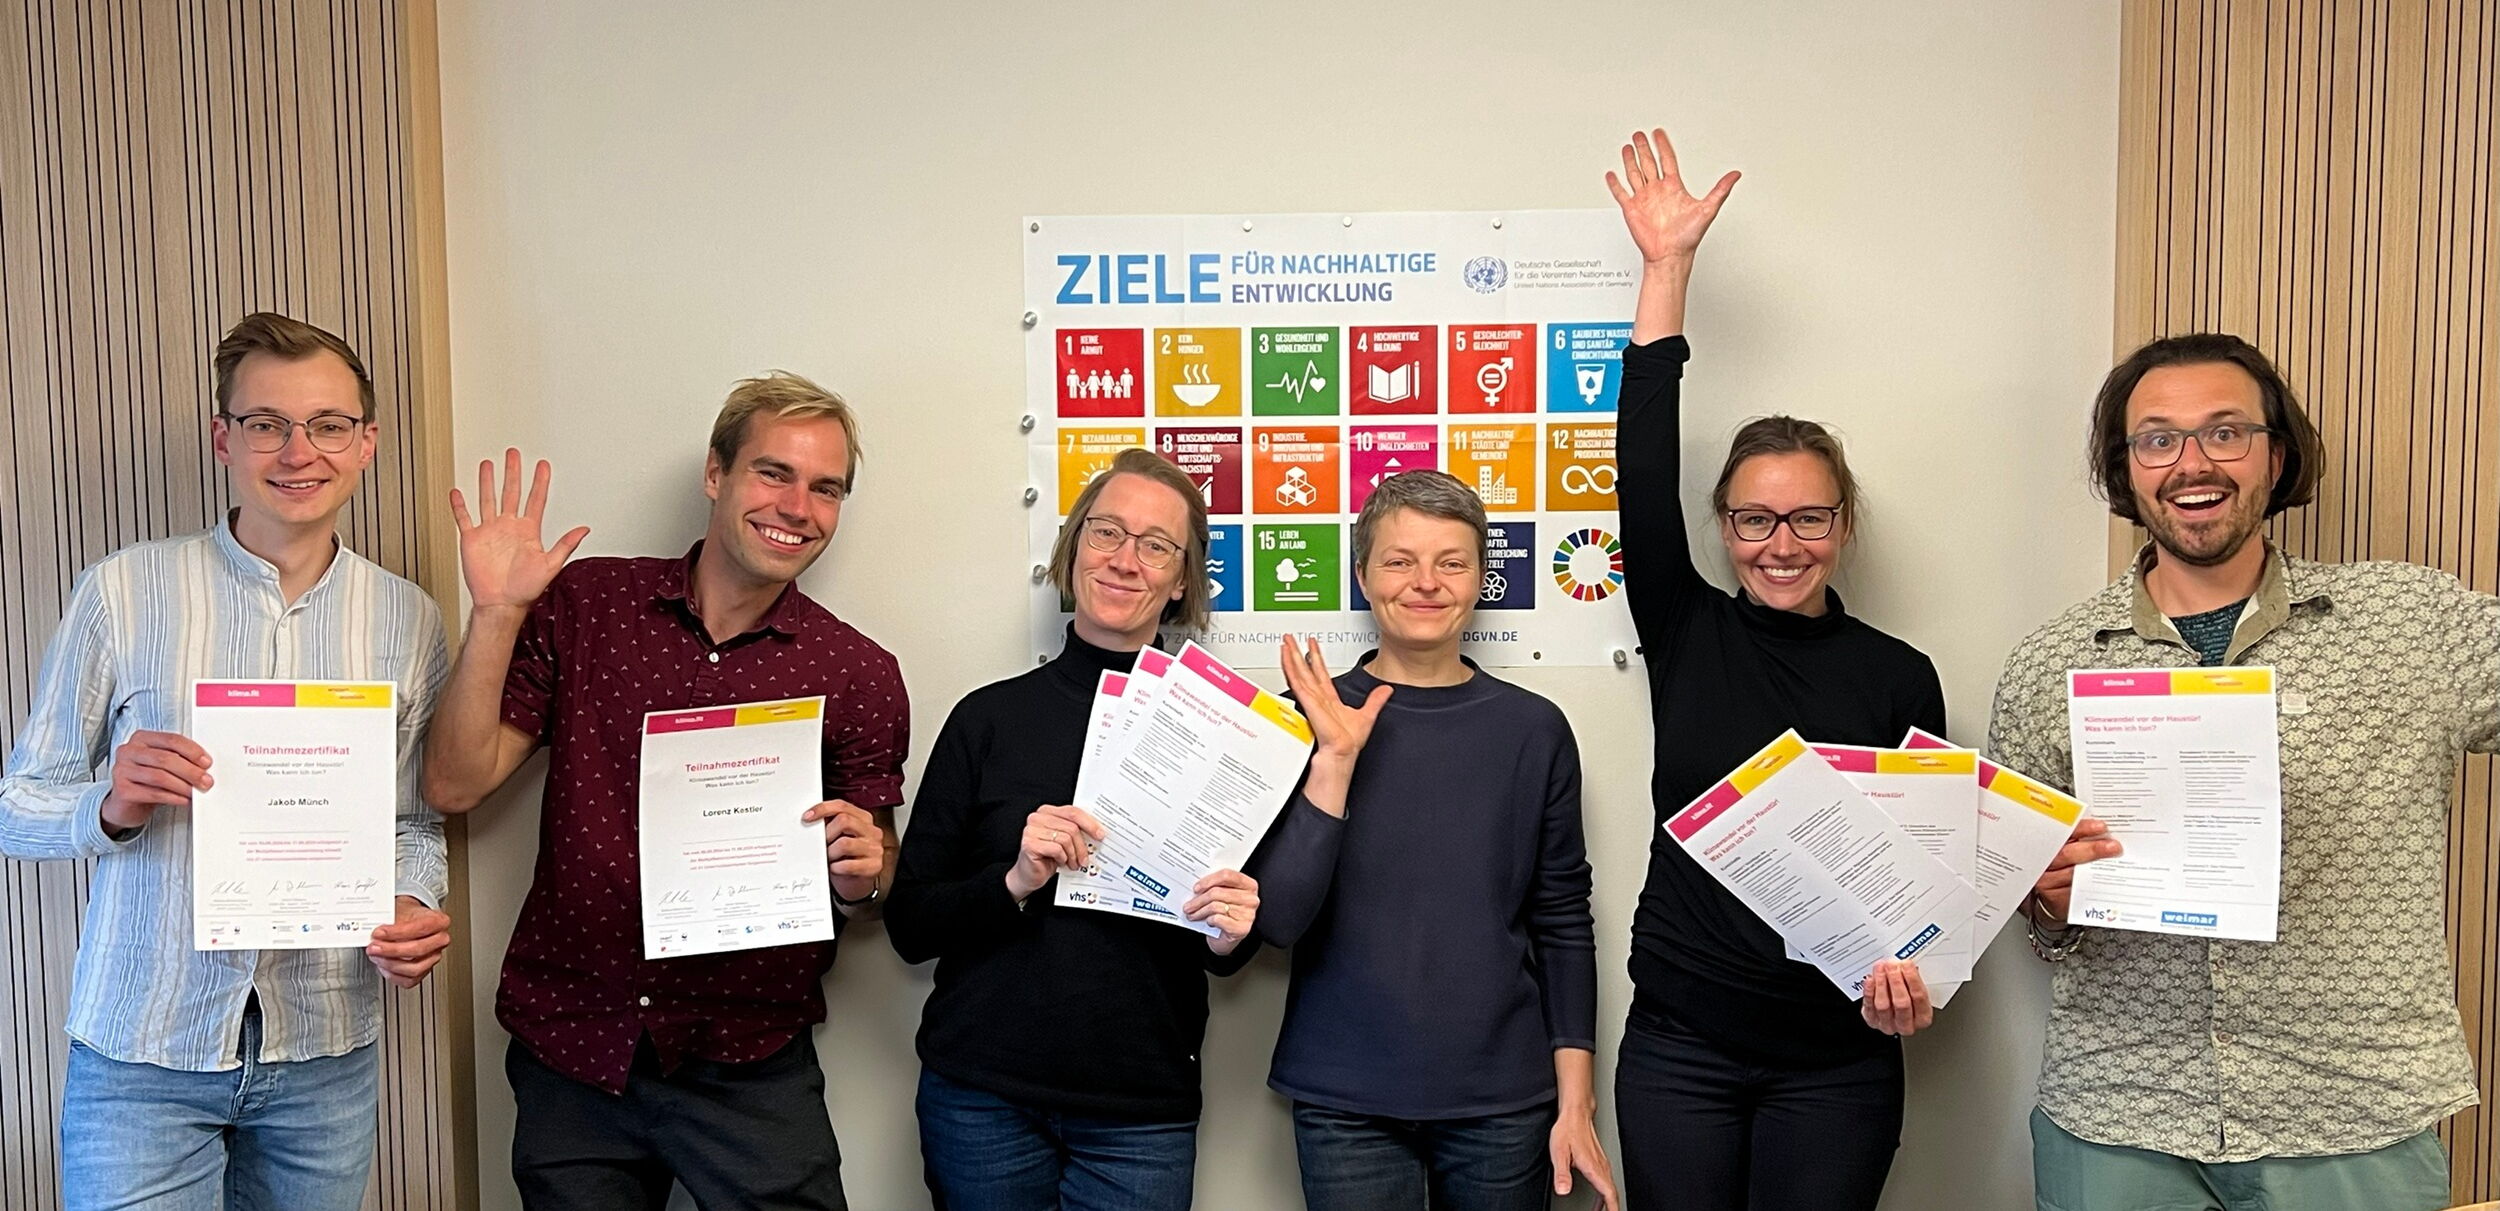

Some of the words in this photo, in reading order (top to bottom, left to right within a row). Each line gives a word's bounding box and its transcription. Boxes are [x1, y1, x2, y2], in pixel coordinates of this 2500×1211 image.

[1232, 251, 1275, 275] FÜR
[1282, 253, 1437, 274] NACHHALTIGE
[1554, 260, 1602, 268] Gesellschaft
[1056, 254, 1221, 304] ZIELE
[1514, 271, 1526, 279] für
[1527, 271, 1539, 279] die
[1541, 271, 1578, 279] Vereinten
[1579, 270, 1615, 278] Nationen
[1616, 270, 1632, 278] e.V.
[1232, 282, 1393, 304] ENTWICKLUNG
[1178, 334, 1193, 344] KEIN
[1275, 333, 1314, 343] GESUNDHEIT
[1315, 333, 1329, 342] UND
[1373, 332, 1420, 342] HOCHWERTIGE
[1473, 330, 1524, 340] GESCHLECHTER-
[1572, 329, 1606, 339] SAUBERES
[1065, 335, 1073, 355] 1
[1080, 335, 1099, 345] KEINE
[1161, 335, 1171, 355] 2
[1259, 333, 1269, 354] 3
[1357, 332, 1368, 353] 4
[1455, 331, 1466, 351] 5
[1555, 330, 1566, 350] 6
[1572, 340, 1586, 349] UND
[1080, 345, 1104, 355] ARMUT
[1178, 345, 1204, 354] HUNGER
[1275, 343, 1322, 353] WOHLERGEHEN
[1373, 342, 1402, 352] BILDUNG
[1473, 341, 1510, 351] GLEICHHEIT
[1081, 434, 1122, 443] BEZAHLBARE
[1123, 434, 1137, 443] UND
[1177, 432, 1238, 442] MENSCHENWÜRDIGE
[1377, 431, 1406, 441] WENIGER
[1471, 430, 1514, 439] NACHHALTIGE
[1552, 429, 1569, 450] 12
[1066, 434, 1075, 454] 7
[1162, 434, 1173, 453] 8
[1259, 433, 1269, 452] 9
[1354, 431, 1372, 452] 10
[1377, 441, 1430, 451] UNGLEICHHEITEN
[1453, 431, 1467, 451] 11
[1472, 440, 1497, 450] STÄDTE
[1497, 440, 1510, 450] UND
[1178, 444, 1199, 453] ARBEIT
[1200, 444, 1213, 453] UND
[1272, 443, 1310, 453] INNOVATION
[1311, 443, 1325, 452] UND
[1177, 454, 1222, 463] WIRTSCHAFTS-
[1272, 453, 1325, 463] INFRASTRUKTUR
[1471, 451, 1508, 460] GEMEINDEN
[1258, 530, 1276, 550] 15
[1279, 530, 1299, 540] LEBEN
[1279, 540, 1289, 550] AN
[1289, 540, 1307, 550] LAND
[1488, 548, 1528, 558] ERREICHUNG
[1488, 559, 1505, 569] ZIELE
[1210, 631, 1235, 644] FÜR
[1327, 631, 1380, 643] ENTWICK
[1459, 631, 1518, 642] .DGVN.DE
[243, 745, 350, 755] Teilnahmezertifikat
[685, 756, 781, 772] Teilnahmezertifikat
[268, 798, 296, 806] Jakob
[298, 798, 329, 806] Münch
[703, 808, 731, 817] Lorenz
[1129, 868, 1167, 895] weimar
[1069, 892, 1087, 902] vhs
[2085, 908, 2105, 920] vhs
[2163, 912, 2214, 925] weimar
[336, 922, 351, 931] vhs
[778, 921, 792, 930] vhs
[1899, 926, 1937, 960] weimar
